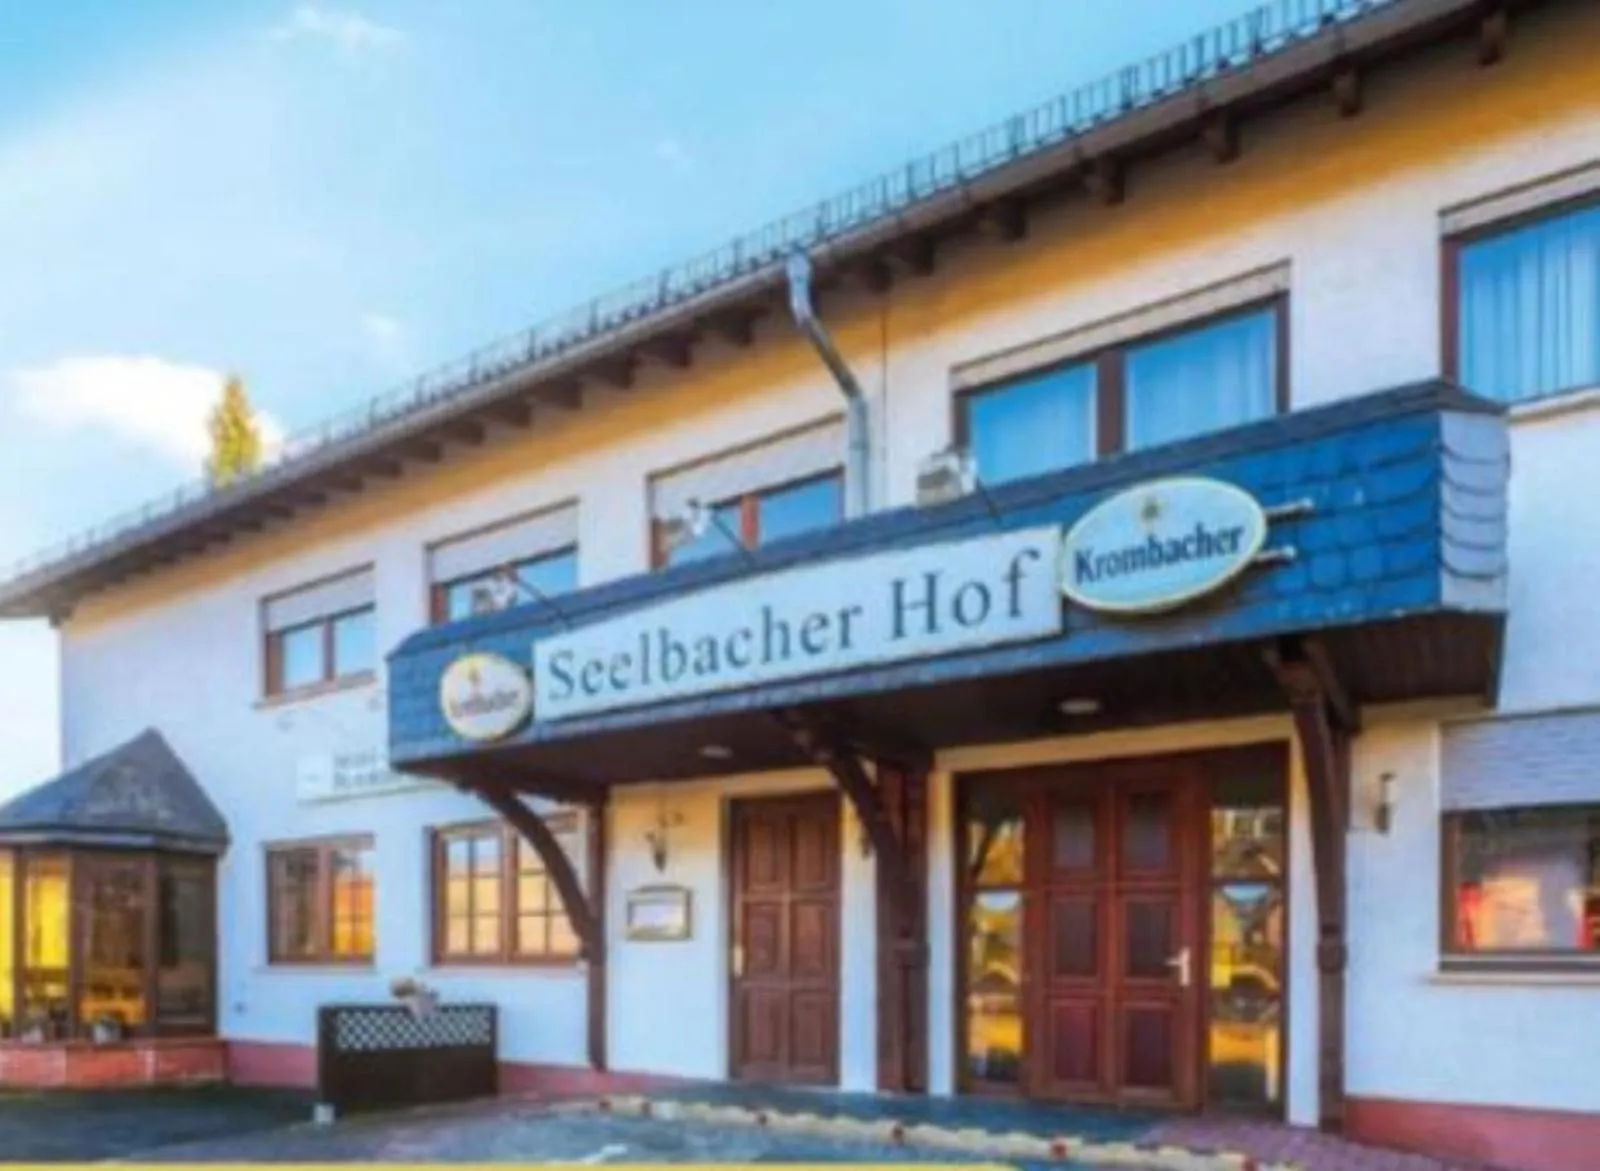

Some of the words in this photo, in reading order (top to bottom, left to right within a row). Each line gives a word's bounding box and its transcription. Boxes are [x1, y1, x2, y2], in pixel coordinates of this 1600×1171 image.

[1075, 522, 1245, 584] Krombacher
[548, 604, 863, 701] Seelbacher
[889, 548, 1041, 640] Hof
